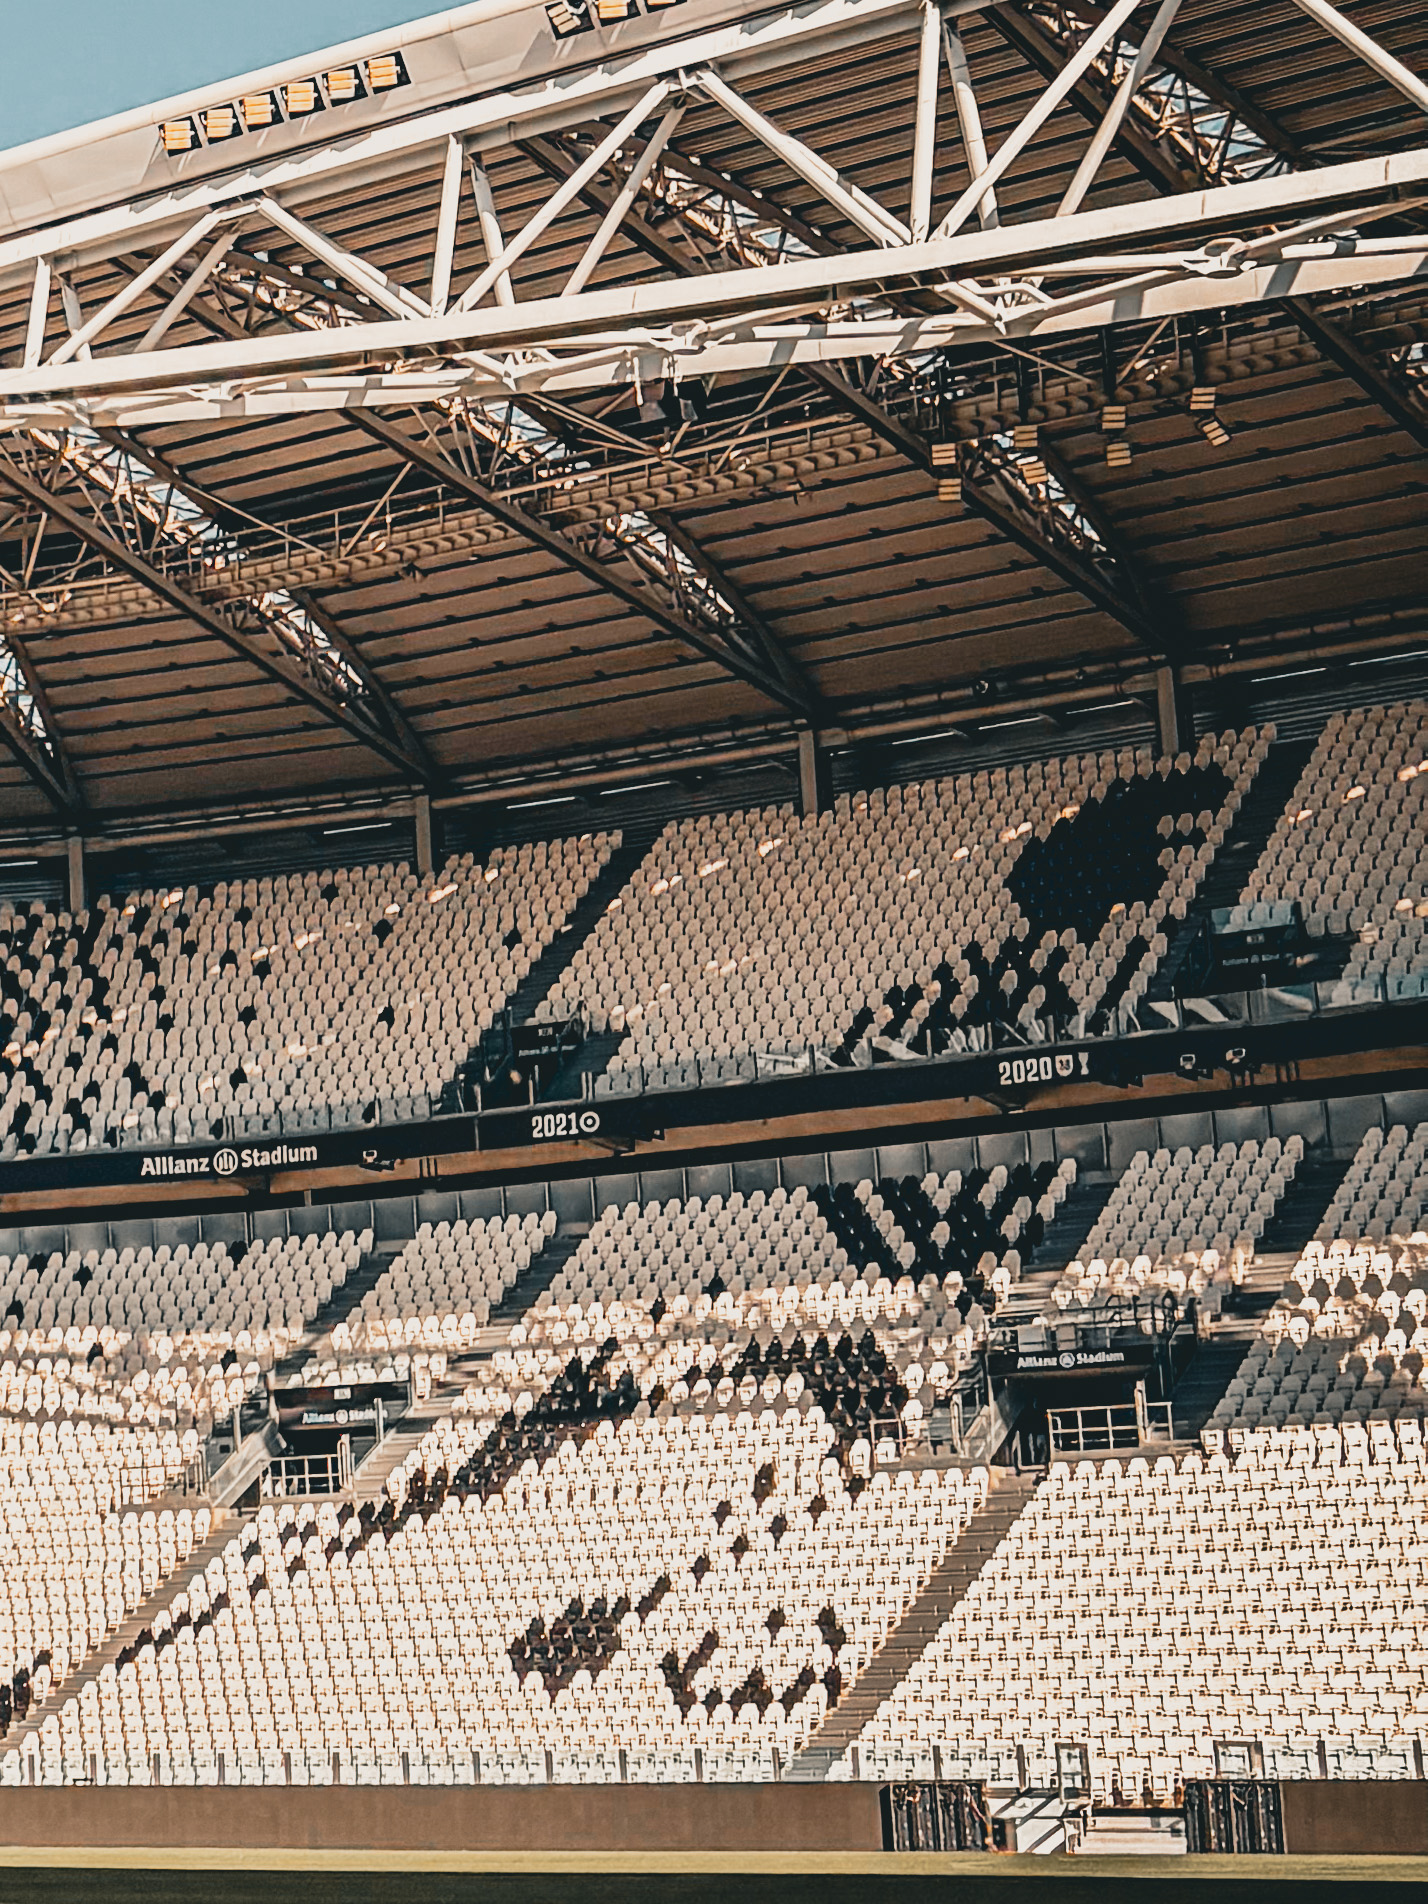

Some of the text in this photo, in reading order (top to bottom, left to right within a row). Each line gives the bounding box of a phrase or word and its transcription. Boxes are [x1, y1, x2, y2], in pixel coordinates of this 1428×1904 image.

[998, 1056, 1053, 1086] 2020
[531, 1112, 579, 1138] 2021
[140, 1144, 318, 1176] Allianz Stadium
